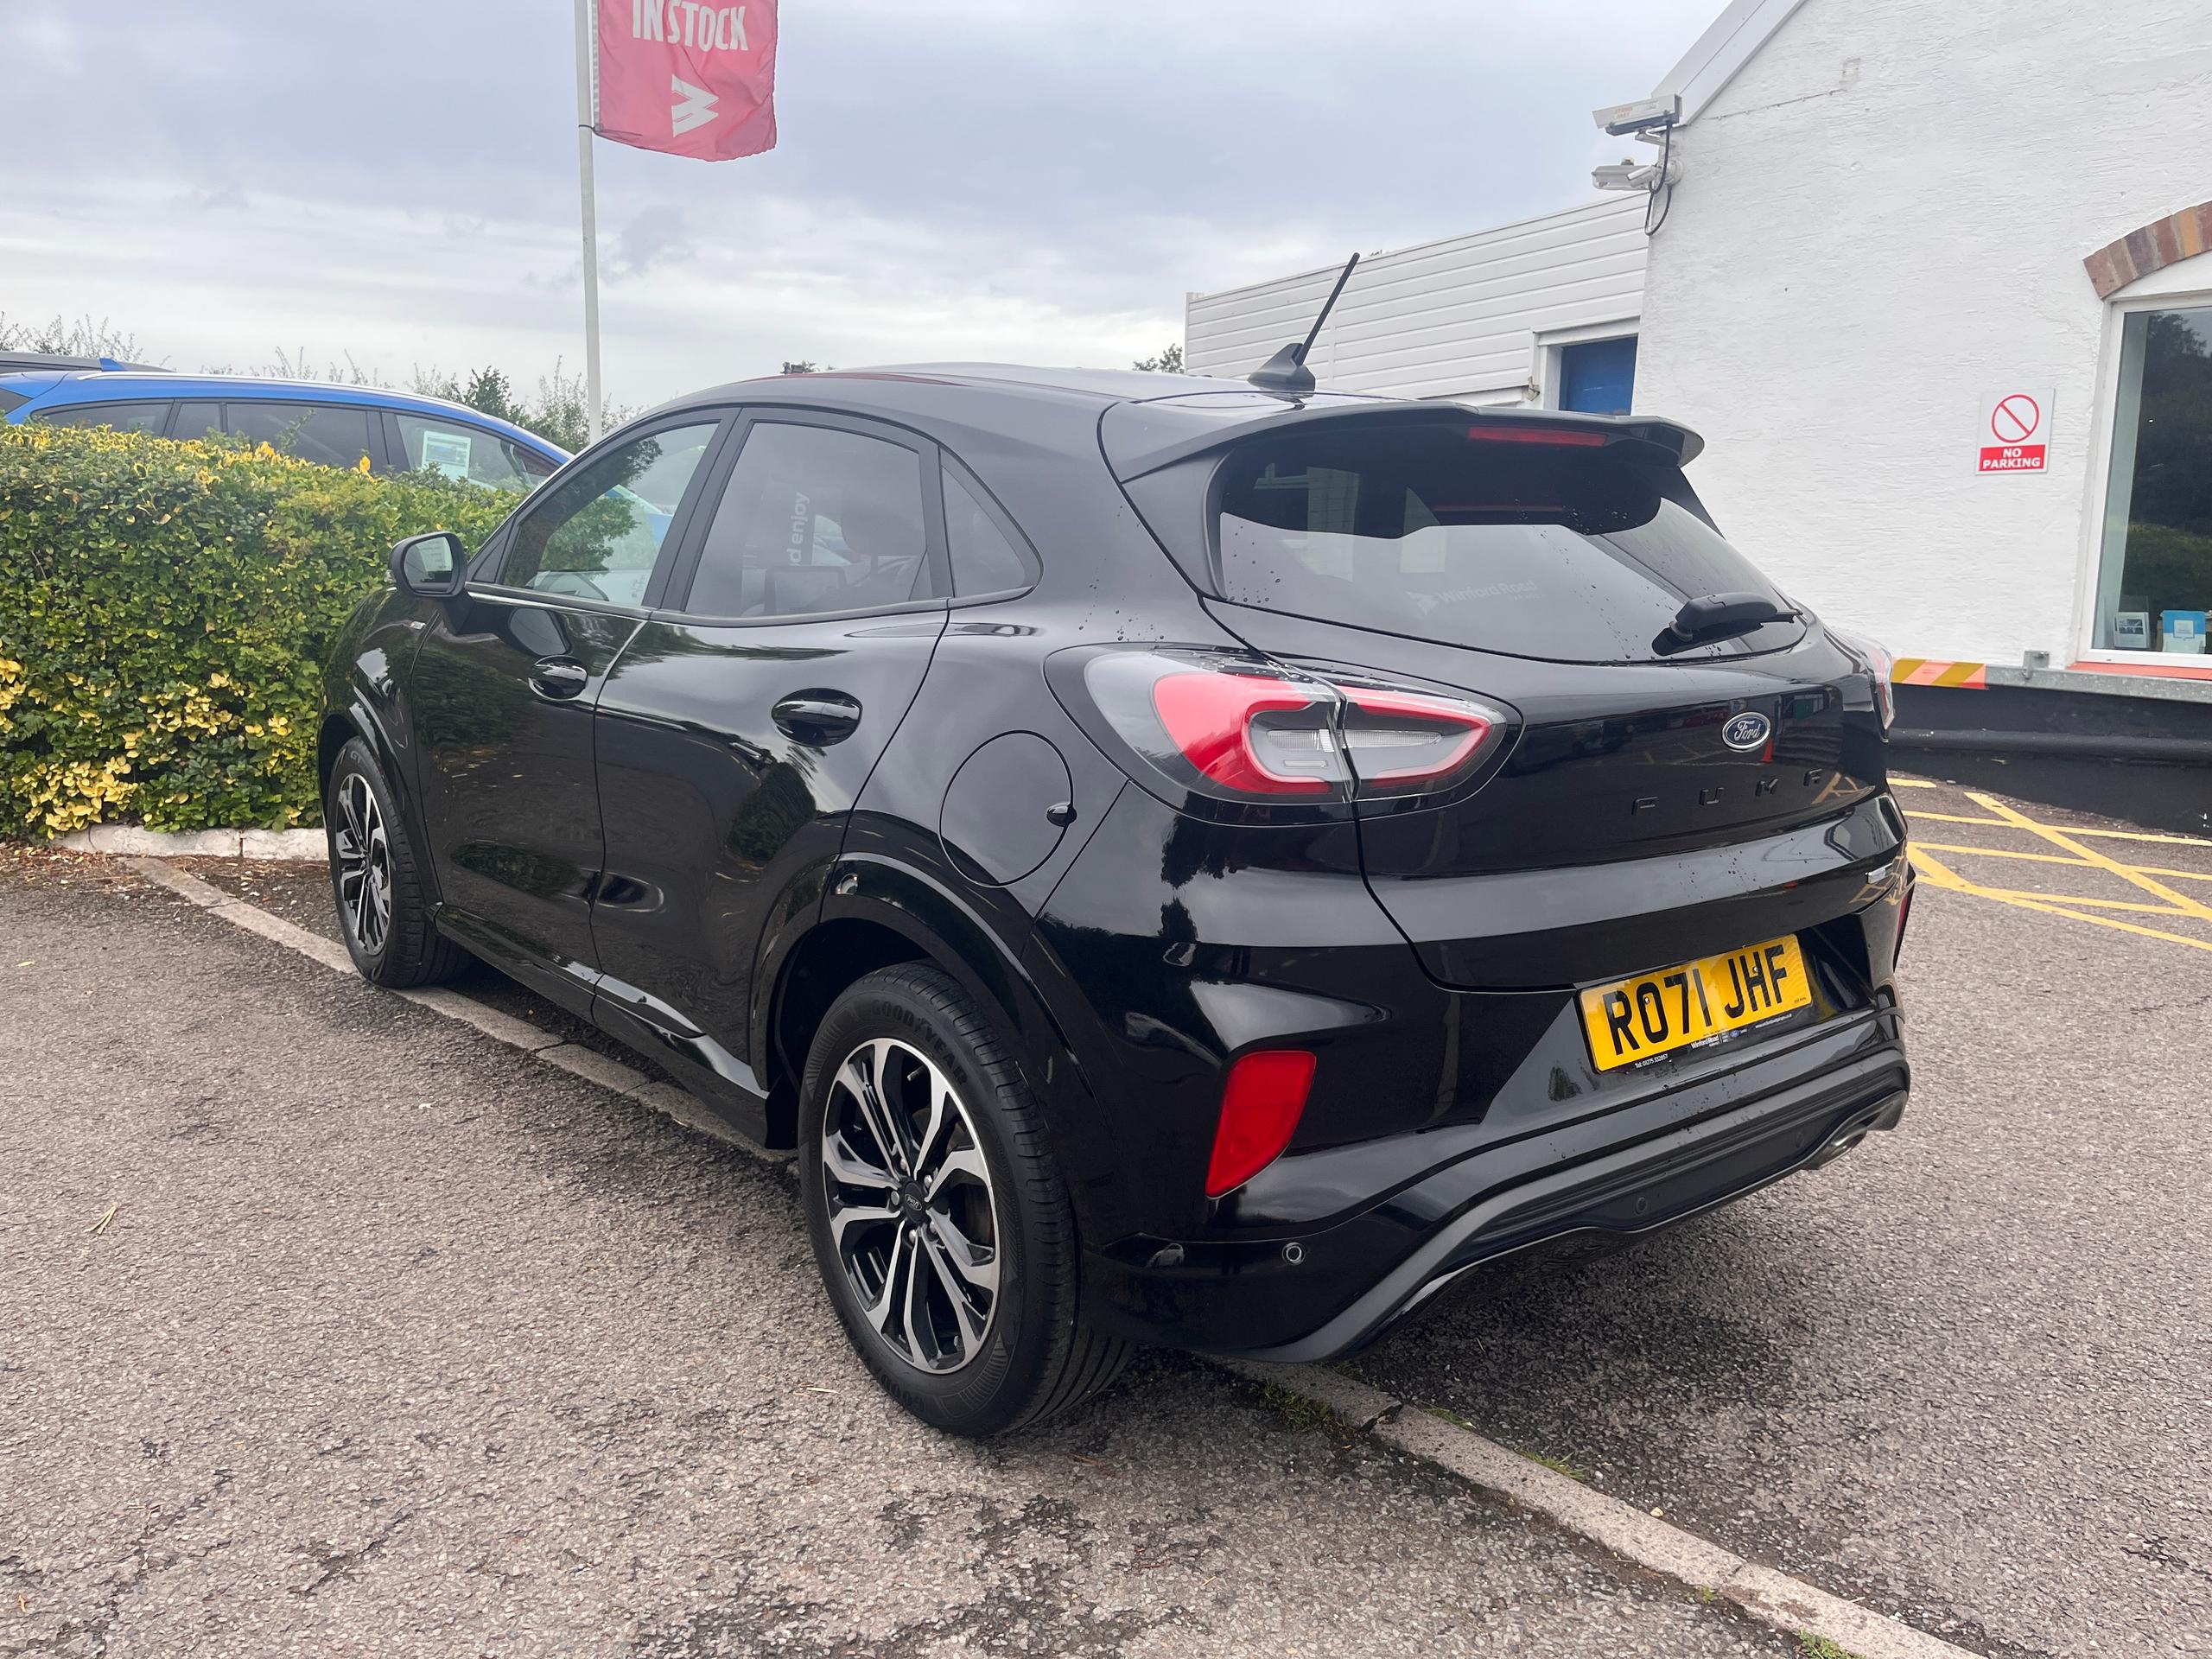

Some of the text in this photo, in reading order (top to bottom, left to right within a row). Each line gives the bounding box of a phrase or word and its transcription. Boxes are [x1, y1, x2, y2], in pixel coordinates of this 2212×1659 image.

[1983, 457, 2040, 469] PARKING
[2003, 448, 2022, 458] NO
[790, 492, 810, 544] enjoy
[1500, 580, 1540, 595] Road
[1733, 720, 1761, 741] Ford
[1602, 944, 1788, 1056] RO71 JHF
[871, 999, 969, 1085] GOODYEAR
